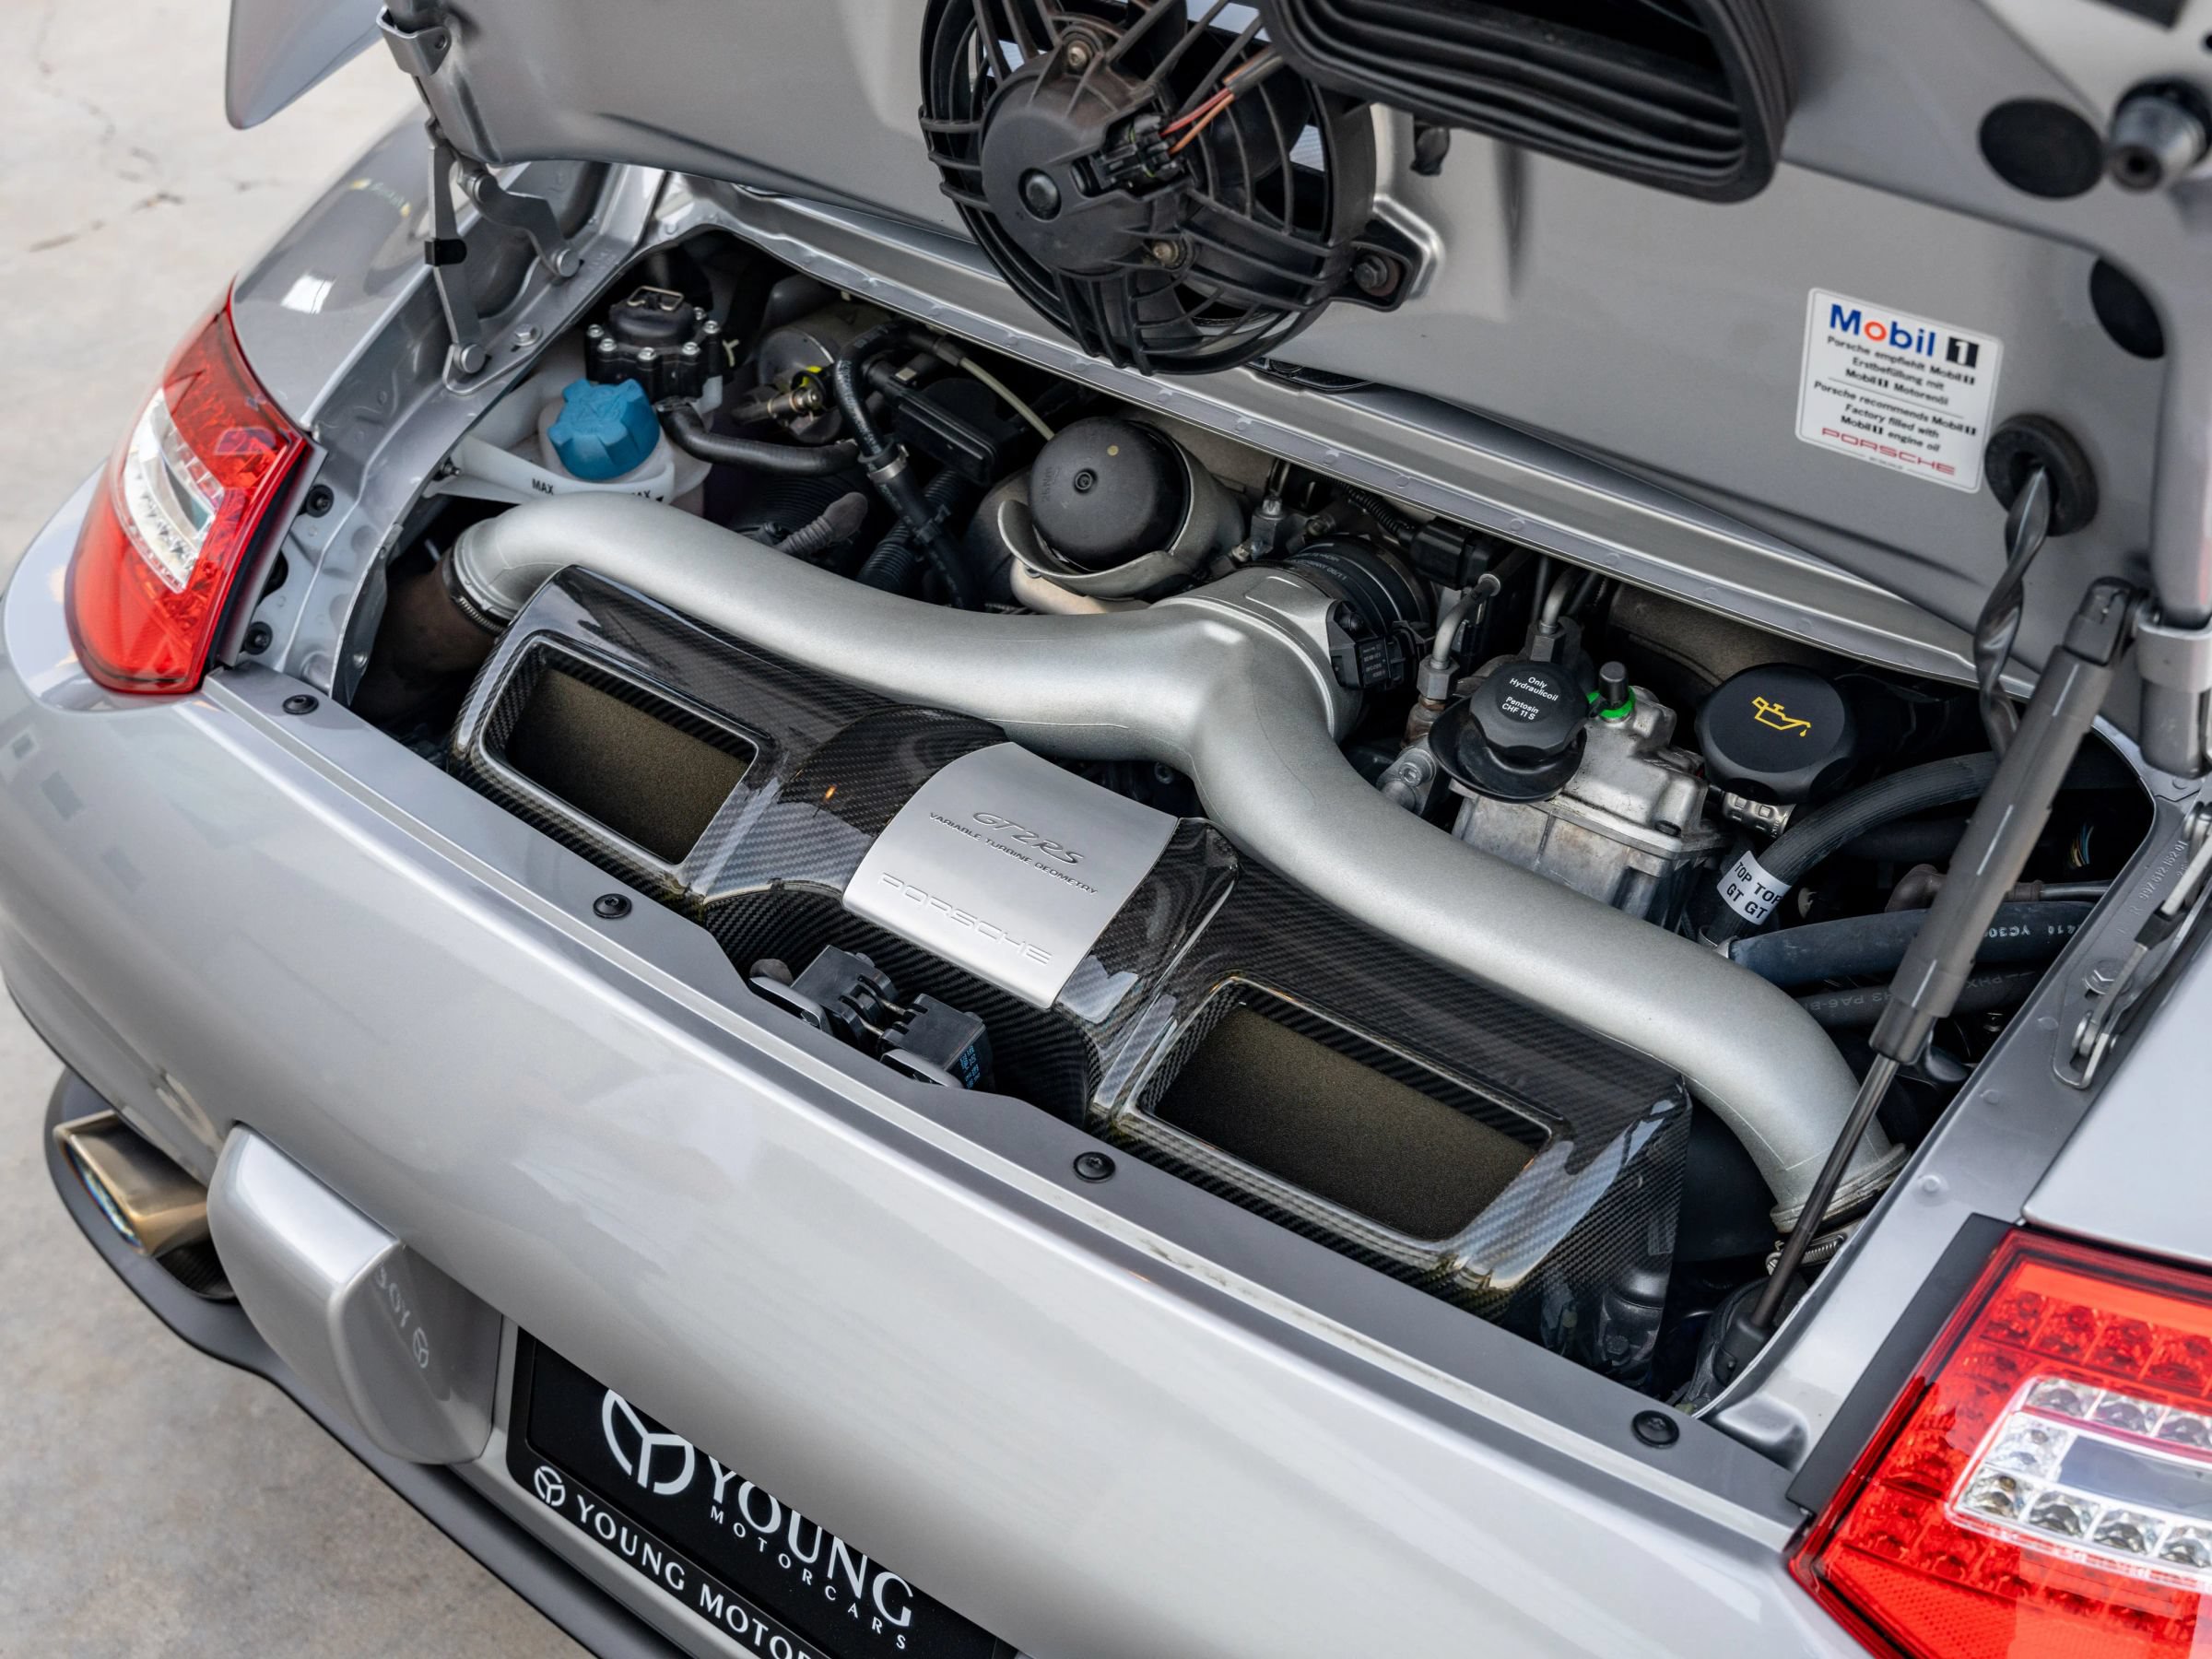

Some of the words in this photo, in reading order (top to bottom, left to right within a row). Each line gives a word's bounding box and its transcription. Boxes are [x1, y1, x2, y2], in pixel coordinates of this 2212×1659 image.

[1830, 303, 1936, 357] Mobil
[1827, 335, 1870, 355] Porsche
[1930, 366, 1961, 382] Mobil
[1845, 368, 1876, 383] Mobil
[1926, 380, 1944, 391] mit
[1814, 381, 1856, 400] Porsche
[1860, 396, 1928, 422] recommends
[1932, 416, 1963, 431] Mobil
[1845, 404, 1886, 424] Factory
[1888, 417, 1914, 431] filled
[1918, 428, 1939, 438] with
[1822, 427, 1956, 476] PORSCHE
[1841, 415, 1872, 430] Mobil
[1888, 431, 1923, 447] engine
[1926, 443, 1940, 452] oil
[532, 478, 553, 495] MAX
[1509, 677, 1559, 701] Hydraulicoil
[1527, 677, 1547, 688] Only
[1501, 703, 1520, 712] CHF
[1520, 710, 1528, 718] 11
[1505, 696, 1539, 714] Pentosin
[928, 812, 982, 841] VARIABLE
[984, 838, 1033, 865] TURBINE
[1033, 862, 1099, 895] GEOMETRY
[1734, 862, 1753, 882] TOP
[880, 872, 1053, 965] PORSCHE
[1726, 883, 1744, 901] GT
[1744, 900, 1768, 919] GT
[577, 1494, 686, 1591] YOUNG
[709, 1455, 913, 1627] YOUNG
[711, 1505, 906, 1650] MOTORCARS
